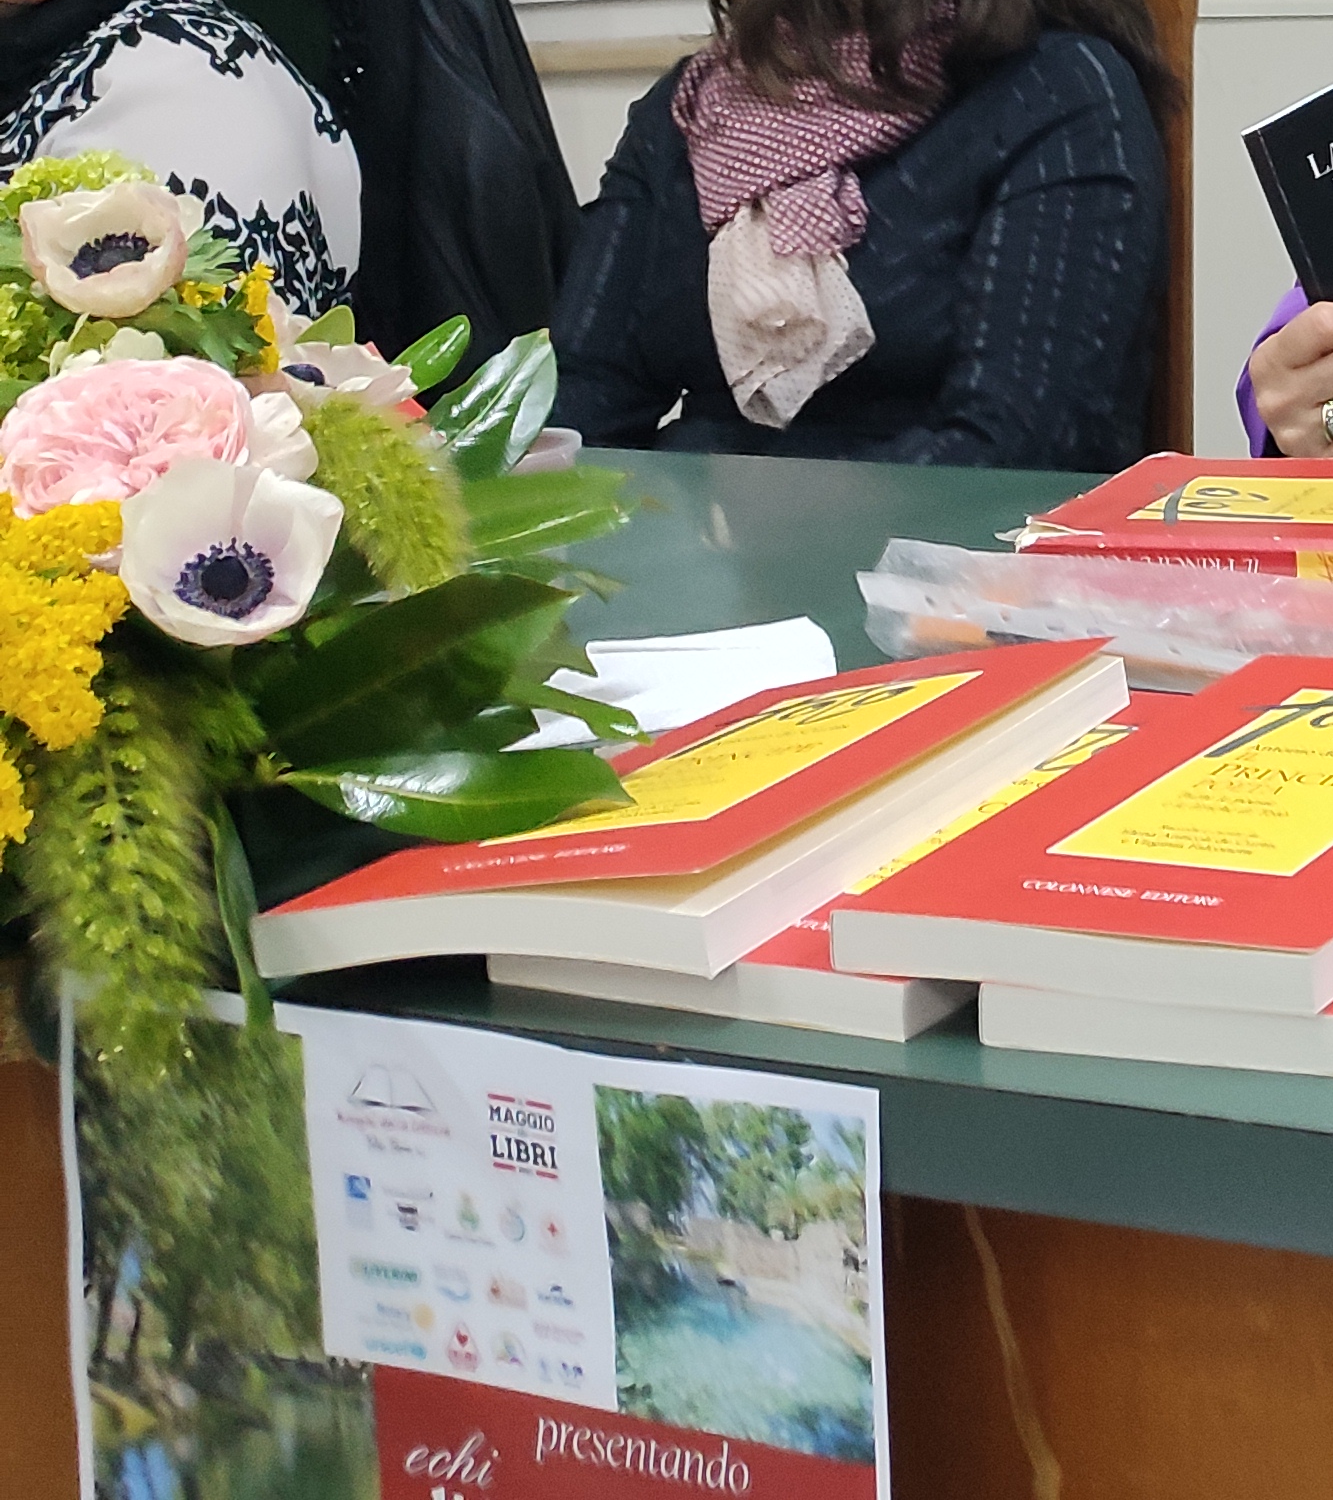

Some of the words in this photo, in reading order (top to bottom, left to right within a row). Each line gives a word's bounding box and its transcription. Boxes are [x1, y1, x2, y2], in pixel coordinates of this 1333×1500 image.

[1022, 879, 1136, 898] COLONNESE
[1140, 889, 1224, 907] EDITORE
[488, 1104, 555, 1134] MAGGIO
[490, 1134, 558, 1170] LIBRI
[404, 1429, 499, 1489] echi
[534, 1415, 751, 1494] presentando
